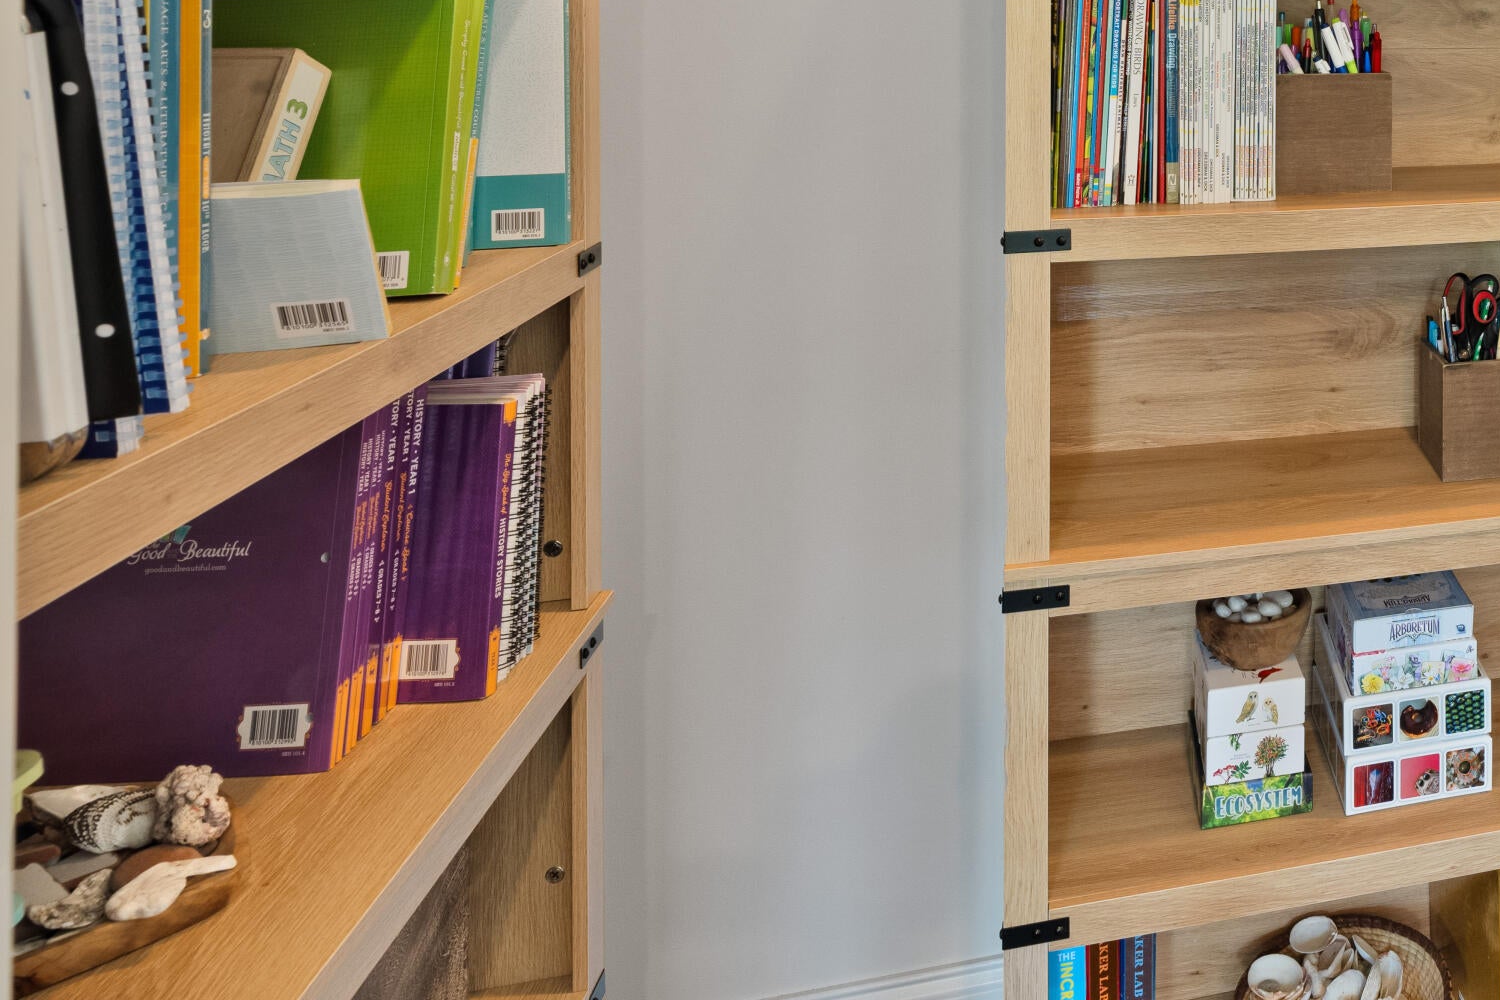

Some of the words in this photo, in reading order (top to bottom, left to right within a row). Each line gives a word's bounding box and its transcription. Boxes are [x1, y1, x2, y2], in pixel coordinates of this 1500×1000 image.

[1168, 0, 1177, 30] Lifelike
[160, 40, 168, 75] ARTS
[1133, 47, 1142, 75] BIRDS
[1166, 33, 1177, 68] Drawing
[160, 80, 167, 91] &
[287, 99, 308, 120] 3
[413, 399, 424, 447] HISTORY
[387, 436, 397, 462] YEAR
[402, 428, 410, 454] YEAR
[408, 457, 419, 487] YEAR
[504, 453, 512, 467] The
[384, 481, 393, 513] Student
[404, 511, 414, 545] Course
[498, 518, 507, 557] HISTORY
[127, 542, 171, 565] Good
[177, 539, 252, 562] Beautiful
[401, 547, 411, 573] Book
[144, 563, 227, 575] goodandbeautiful.com
[495, 560, 503, 599] STORIES
[1389, 618, 1440, 641] ARBORETUM
[1215, 785, 1302, 819] ECOSYSTEM
[1057, 952, 1076, 962] THE
[1134, 970, 1144, 997] LAB
